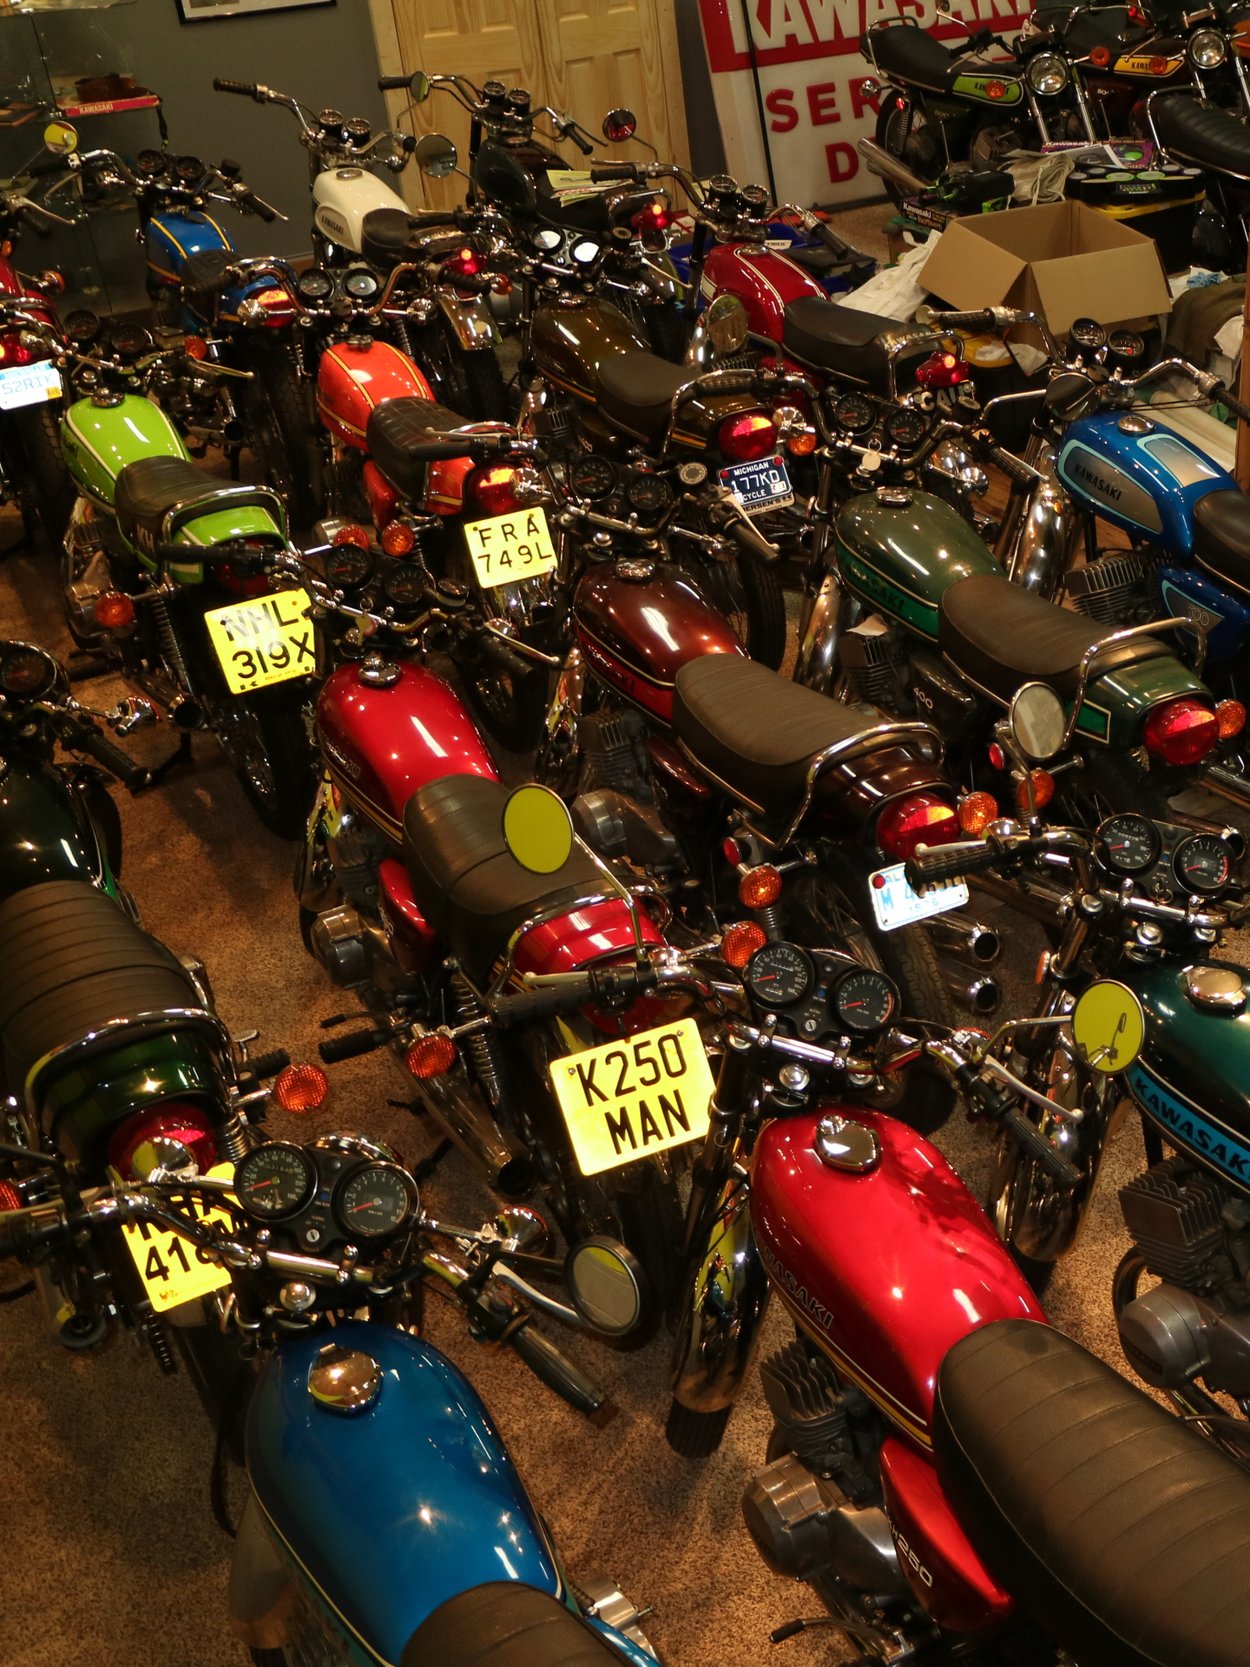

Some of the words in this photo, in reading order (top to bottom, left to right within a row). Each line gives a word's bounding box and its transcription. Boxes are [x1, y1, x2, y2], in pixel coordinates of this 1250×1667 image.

[80, 103, 113, 114] KAWASAKI
[731, 469, 781, 493] 177KD
[733, 461, 769, 476] MICHIGAN
[1073, 463, 1122, 501] KAWASAKI
[743, 489, 767, 501] CYCLE
[478, 513, 541, 548] FRA
[477, 542, 553, 573] 749L
[220, 600, 300, 643] NHL
[231, 631, 315, 680] 319X
[576, 1033, 688, 1107] K250
[604, 1089, 691, 1155] MAN
